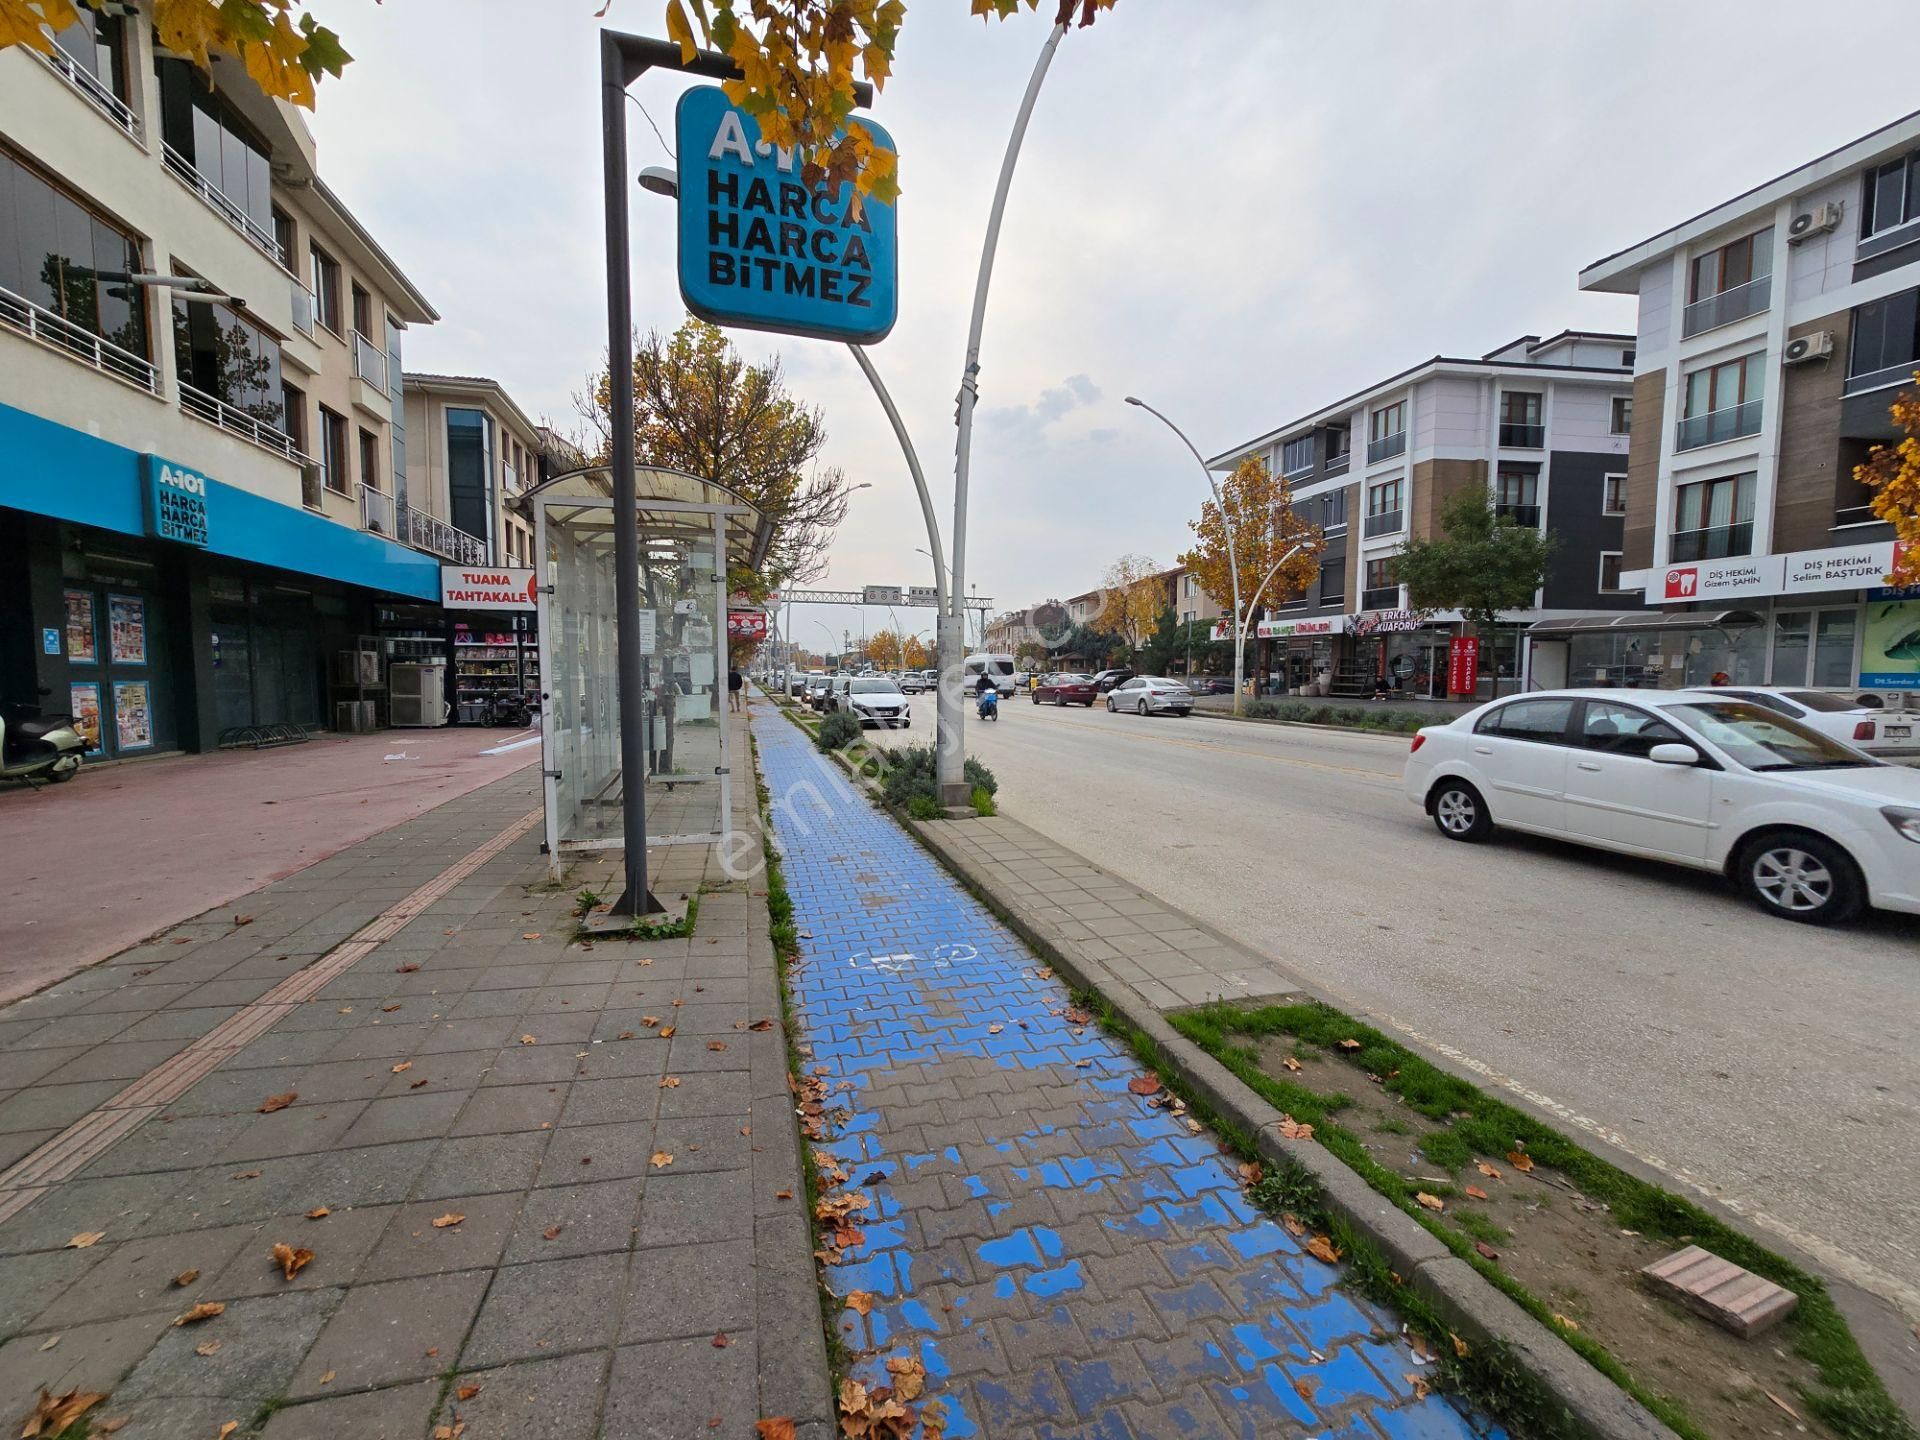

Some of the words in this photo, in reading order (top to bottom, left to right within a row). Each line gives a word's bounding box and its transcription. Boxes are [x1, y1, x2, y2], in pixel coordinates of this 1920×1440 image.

[708, 169, 872, 234] HARCA
[708, 210, 872, 271] HARCA
[160, 489, 206, 516] HARCA
[161, 506, 207, 530] HARCA
[462, 573, 511, 585] TUANA
[1704, 580, 1730, 588] Gizem
[1732, 576, 1761, 587] ŞAHİN
[1792, 573, 1821, 582] Selim
[447, 590, 527, 603] TAHTAKALE
[1383, 610, 1412, 620] ERKEK
